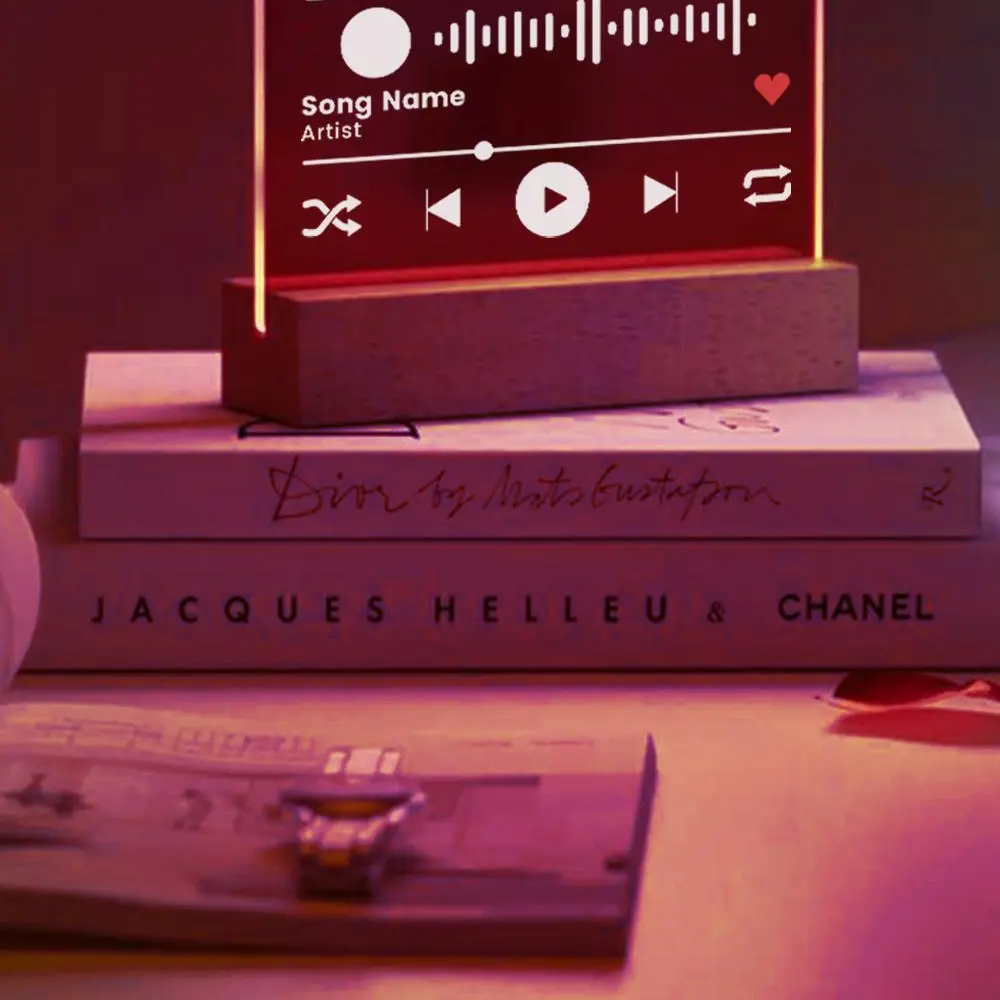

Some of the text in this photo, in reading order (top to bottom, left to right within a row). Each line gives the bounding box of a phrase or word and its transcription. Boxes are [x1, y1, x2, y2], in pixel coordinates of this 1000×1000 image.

[302, 89, 466, 120] Song Name
[300, 121, 362, 142] Artist
[268, 455, 408, 522] Dior
[417, 469, 475, 518] by
[90, 593, 935, 624] JACQUES HELLEU & CHANEL
